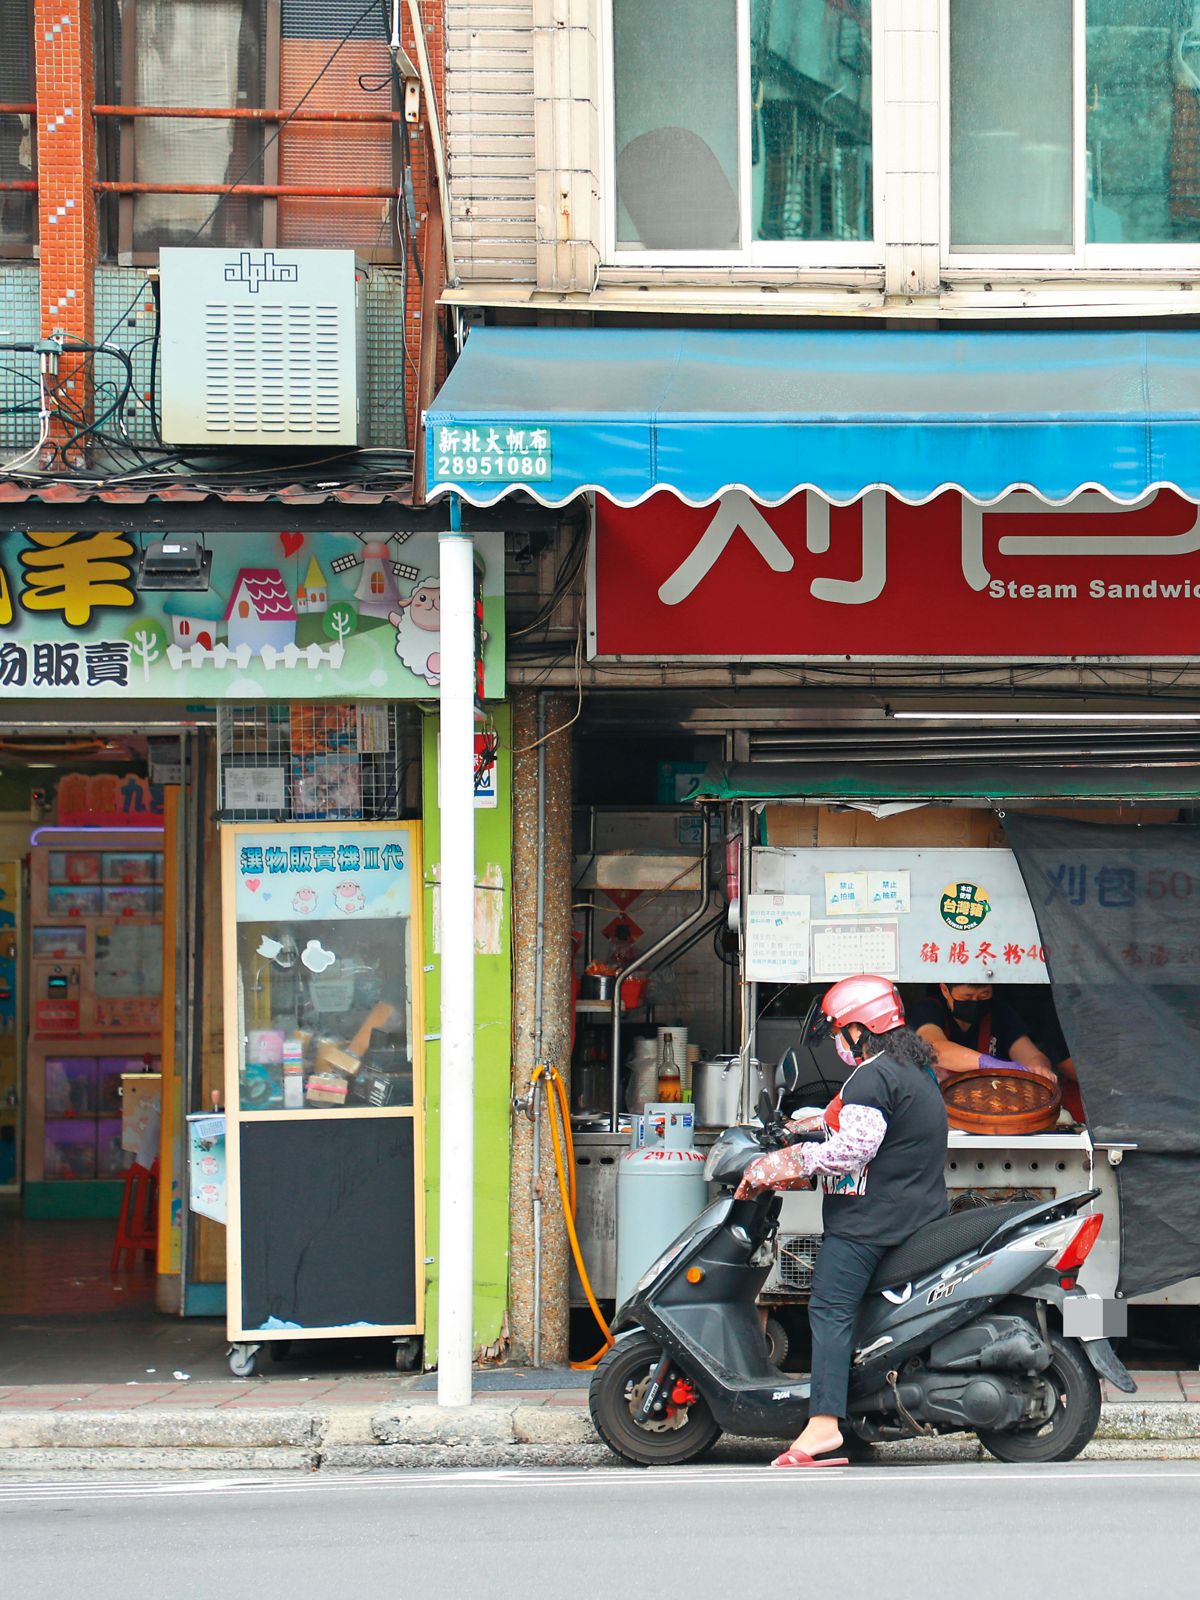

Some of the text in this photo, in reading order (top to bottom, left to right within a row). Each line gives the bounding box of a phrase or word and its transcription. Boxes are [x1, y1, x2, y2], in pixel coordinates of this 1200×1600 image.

[438, 428, 547, 455] 新北大帆布
[438, 457, 547, 475] 28951080
[989, 579, 1077, 598] Steam
[772, 1391, 790, 1400] SYM
